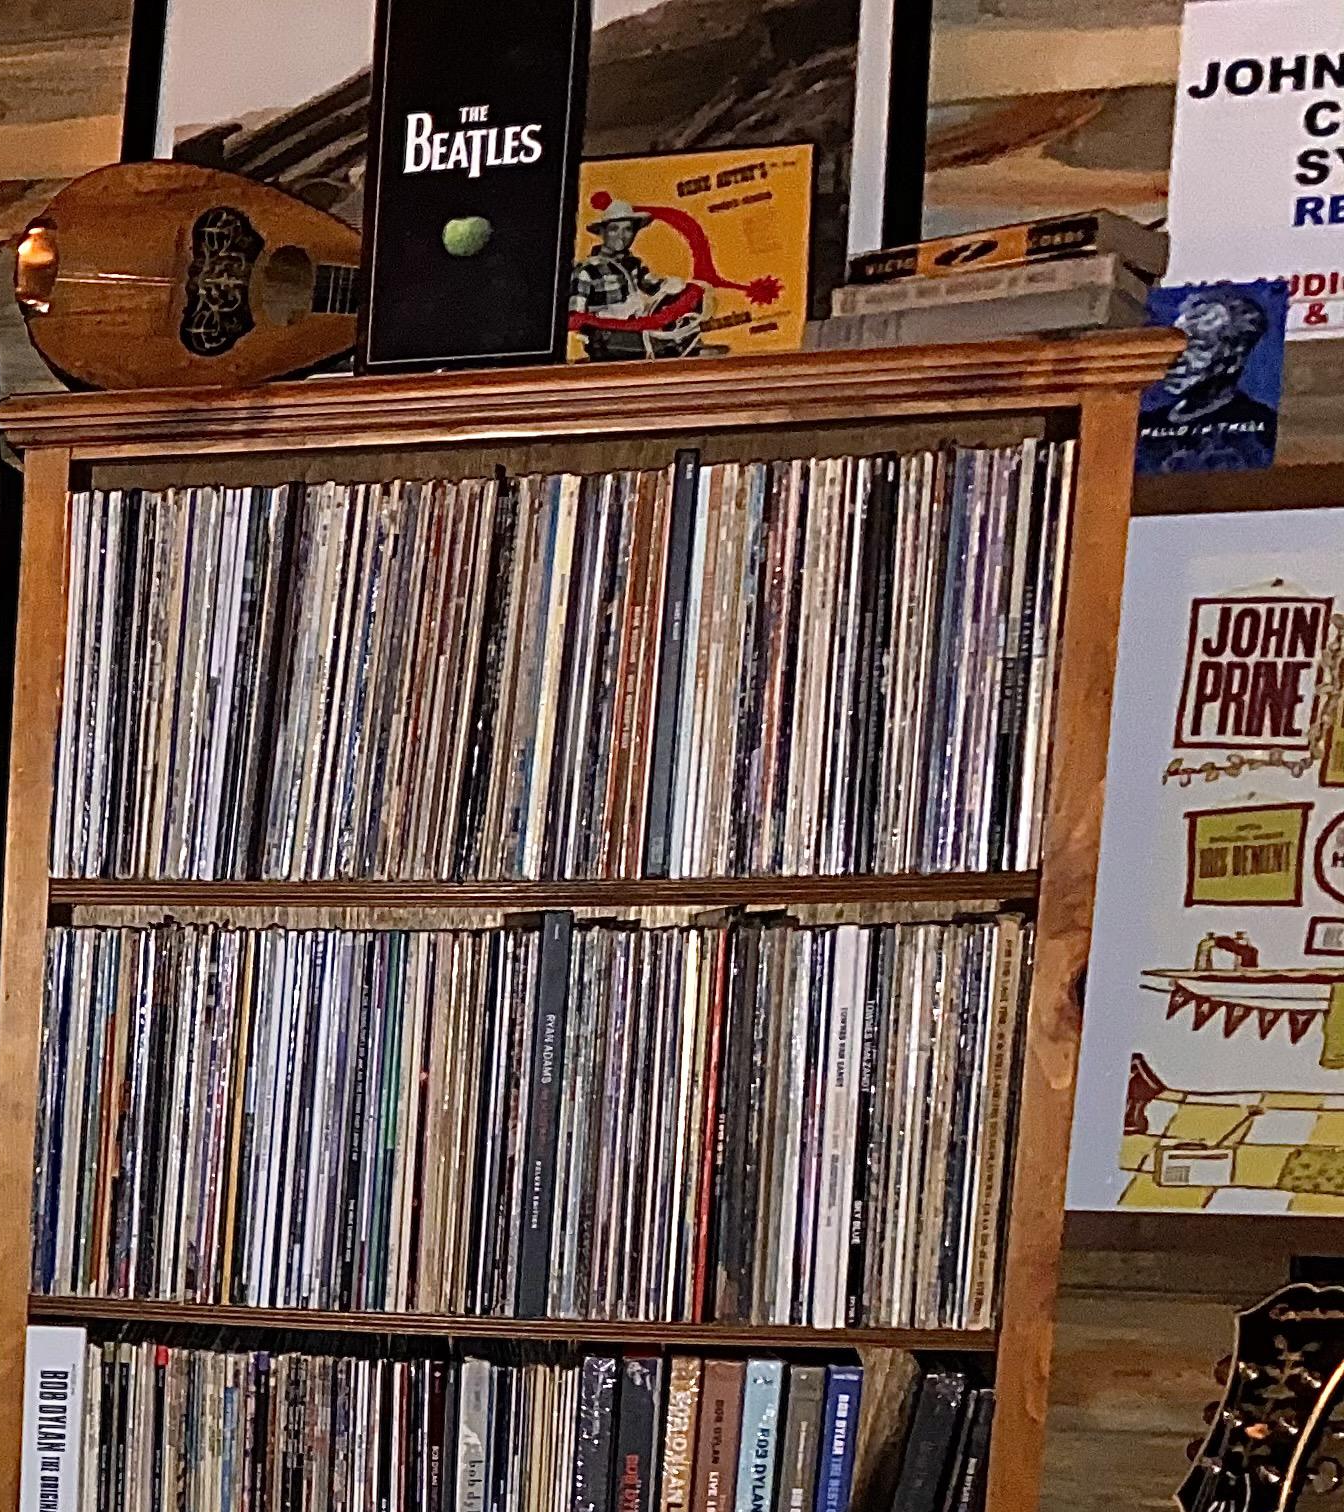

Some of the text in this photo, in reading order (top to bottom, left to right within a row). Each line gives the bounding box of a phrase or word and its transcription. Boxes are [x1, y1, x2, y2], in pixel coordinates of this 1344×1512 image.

[1188, 53, 1344, 99] JOHN
[459, 105, 490, 123] THE
[403, 112, 543, 179] BEATLES
[1202, 605, 1322, 659] JOHN
[1190, 659, 1313, 738] PRINE
[544, 1014, 556, 1044] RYAN
[541, 1045, 554, 1084] ADAMS
[861, 1061, 872, 1093] ZANDT
[39, 1370, 69, 1401] BOB
[714, 1400, 725, 1423] BOB
[836, 1394, 850, 1418] BOB
[36, 1405, 68, 1453] DYLAN
[755, 1428, 770, 1459] BOB
[832, 1420, 848, 1455] DYLAN
[431, 1445, 440, 1460] BOB
[711, 1428, 723, 1464] DYLAN
[40, 1456, 61, 1472] THE
[431, 1461, 440, 1486] DYLAN
[467, 1460, 484, 1486] bob
[708, 1471, 720, 1497] LIVE
